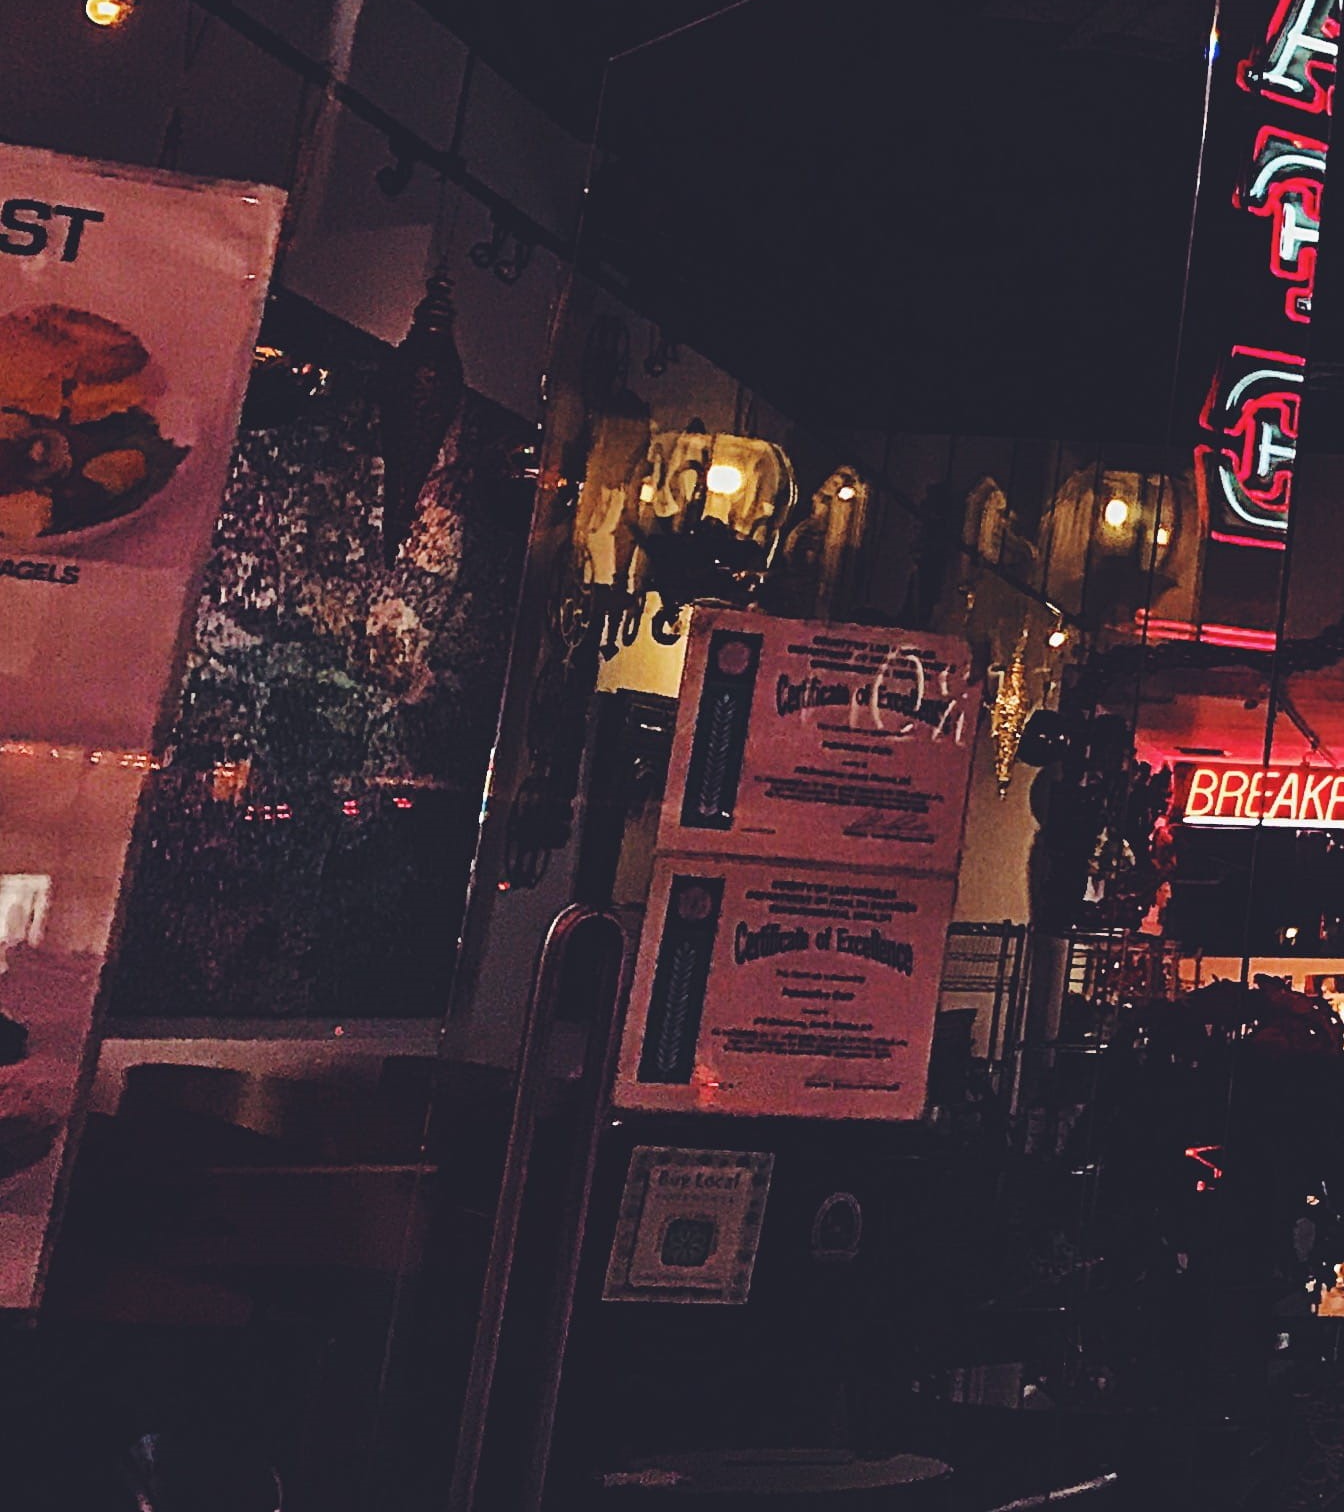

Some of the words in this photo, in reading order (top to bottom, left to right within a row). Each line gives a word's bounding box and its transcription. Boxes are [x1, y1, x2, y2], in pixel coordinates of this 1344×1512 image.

[734, 920, 810, 965] Certificate
[814, 926, 833, 951] of
[836, 928, 914, 976] Excellence
